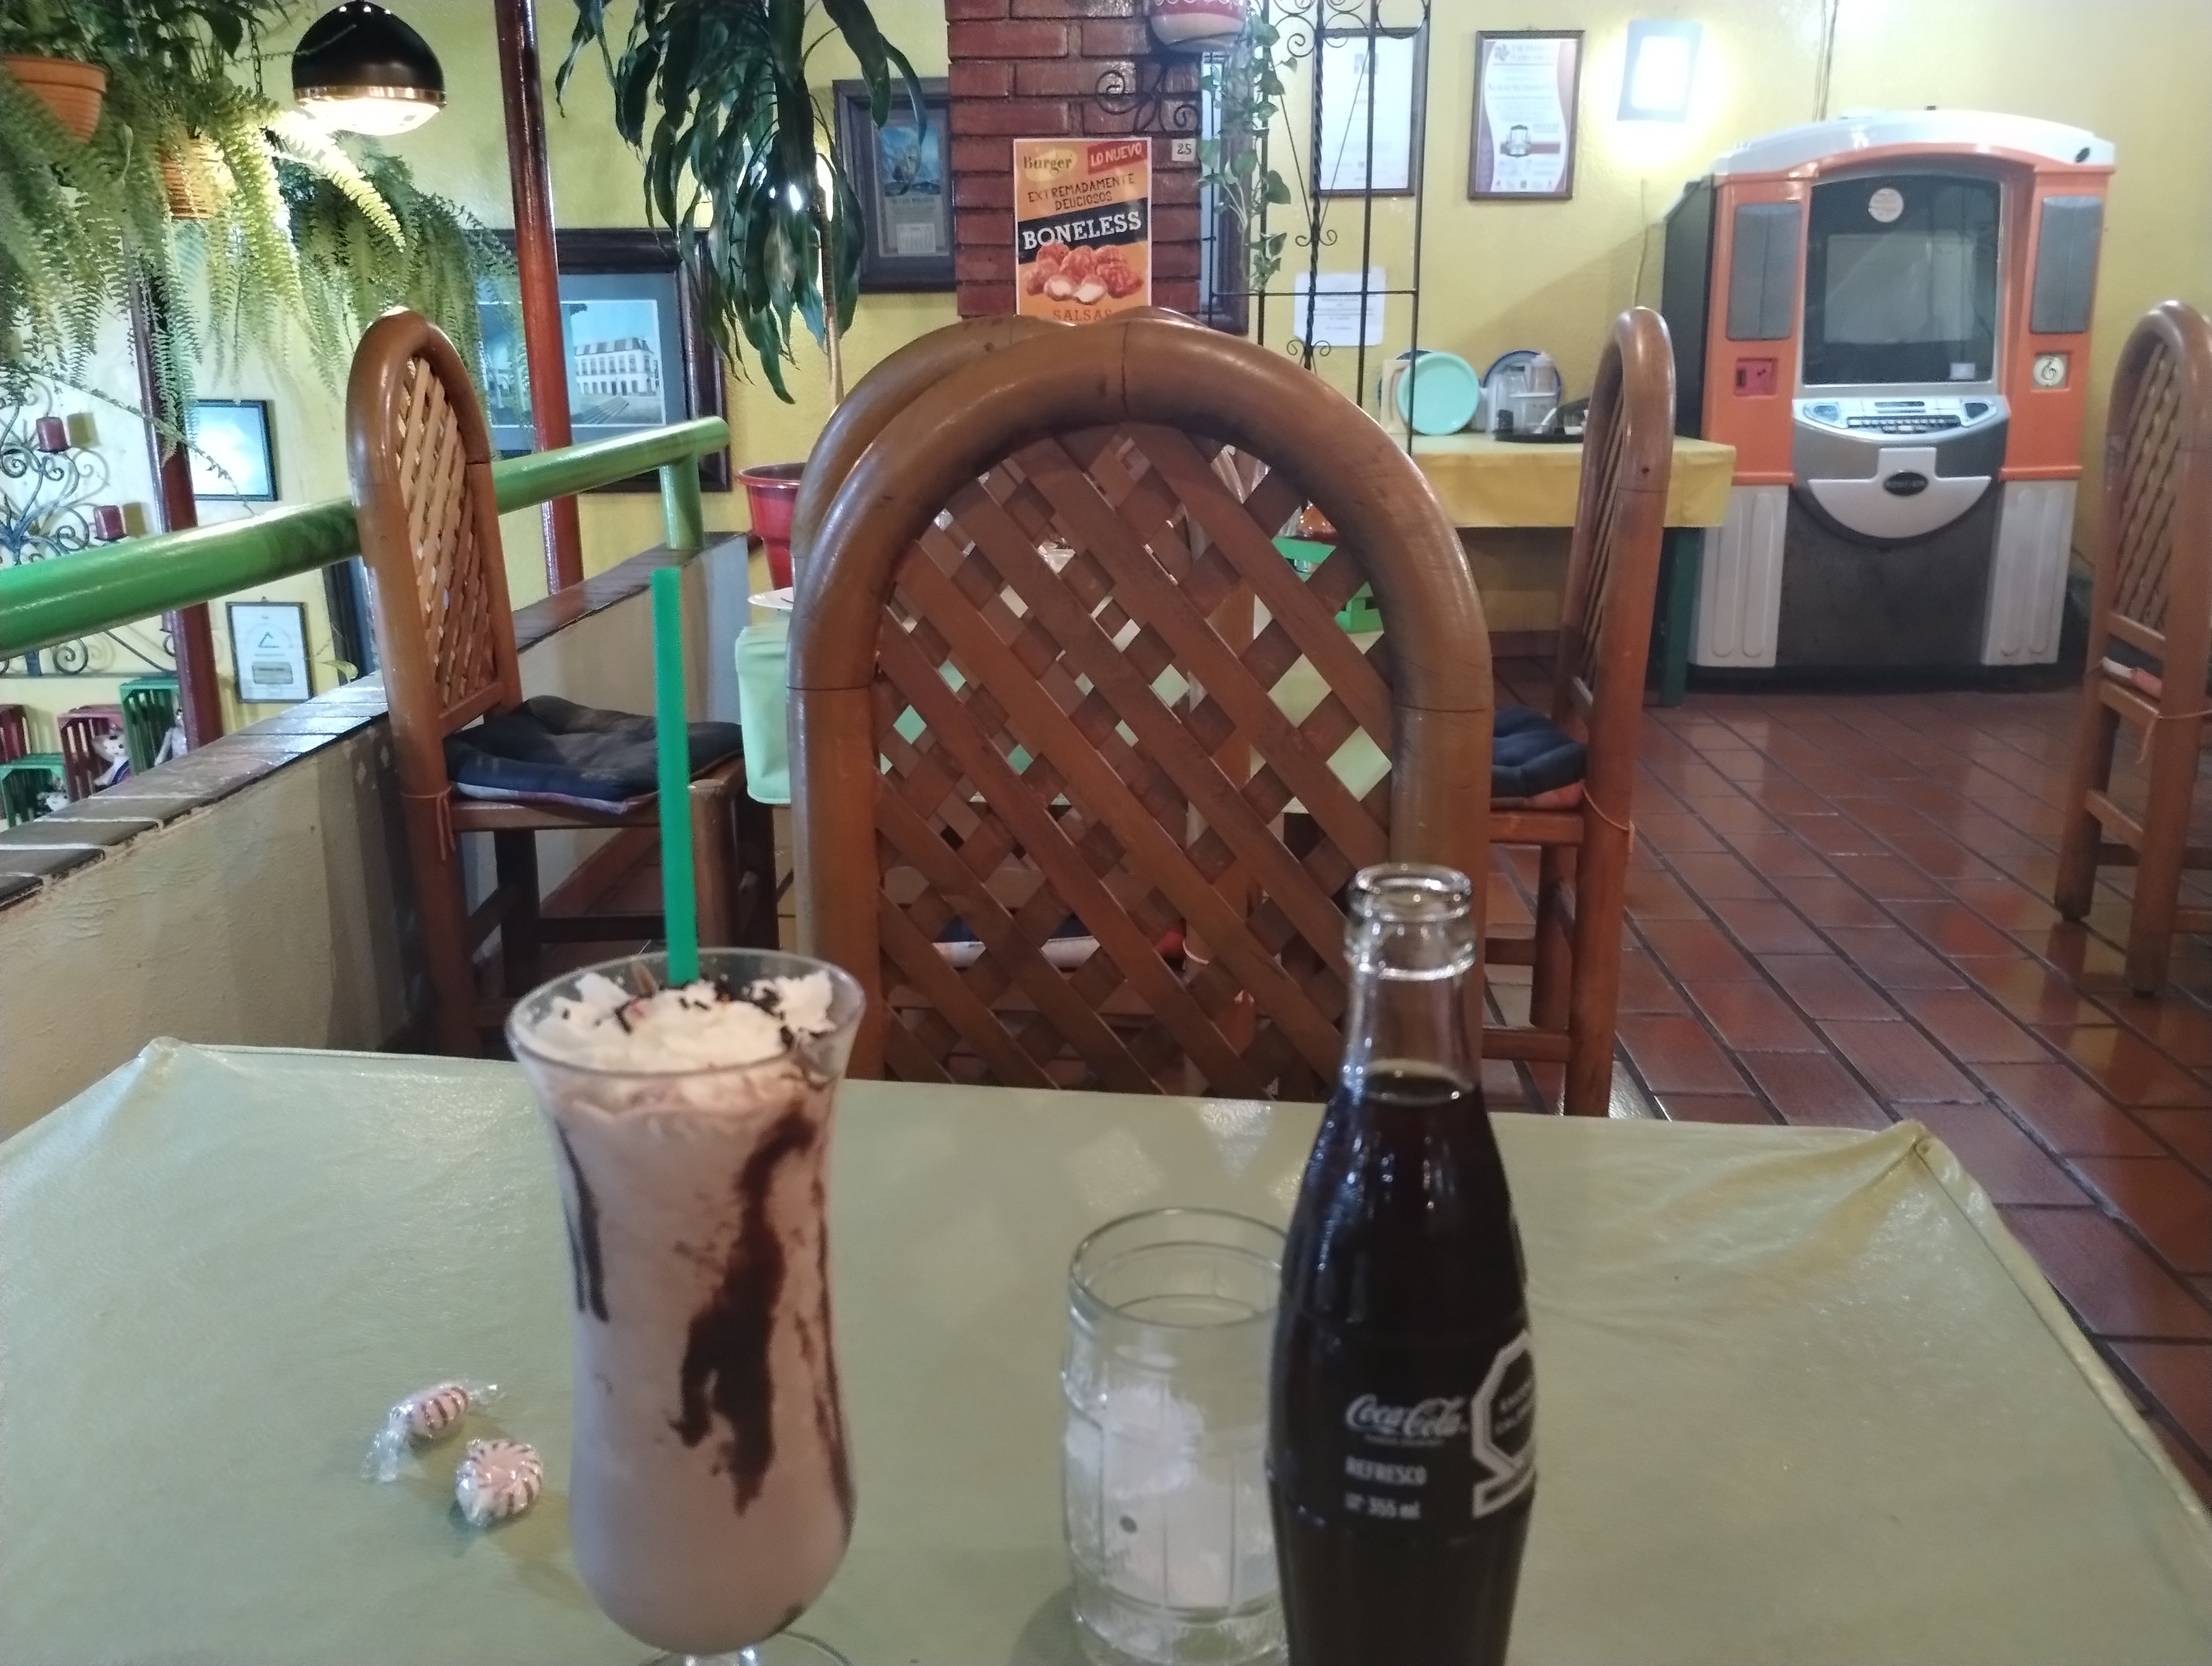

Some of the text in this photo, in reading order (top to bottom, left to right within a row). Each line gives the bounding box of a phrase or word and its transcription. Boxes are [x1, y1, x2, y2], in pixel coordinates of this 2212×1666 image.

[1177, 143, 1192, 155] 25
[1024, 155, 1072, 176] Burger
[1027, 173, 1135, 203] EXTREMADAMENTE
[1022, 211, 1142, 250] BONELESS
[1345, 1455, 1427, 1486] REFRESCO
